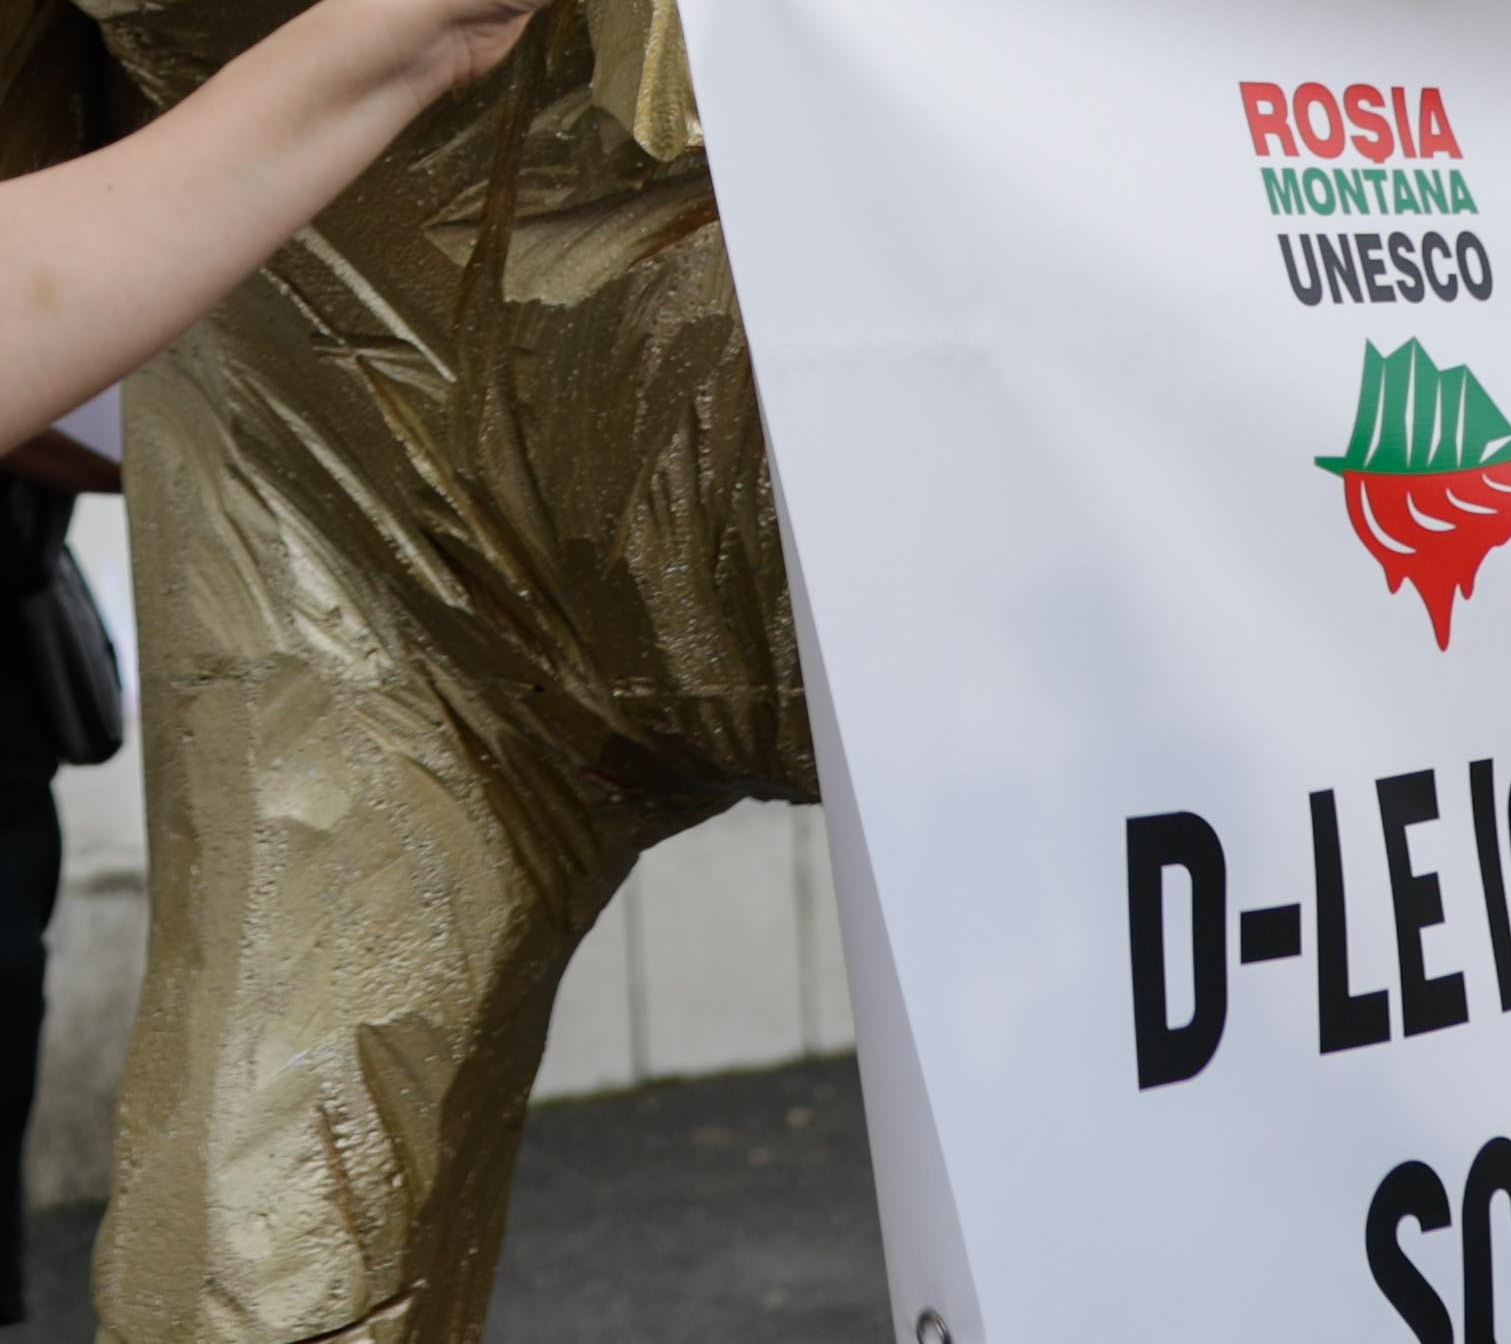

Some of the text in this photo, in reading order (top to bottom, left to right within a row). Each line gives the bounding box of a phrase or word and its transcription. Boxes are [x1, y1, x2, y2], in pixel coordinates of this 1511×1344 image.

[1261, 167, 1479, 215] MONTANA
[1278, 231, 1493, 306] UNESCO
[1126, 769, 1470, 1091] D-LE
